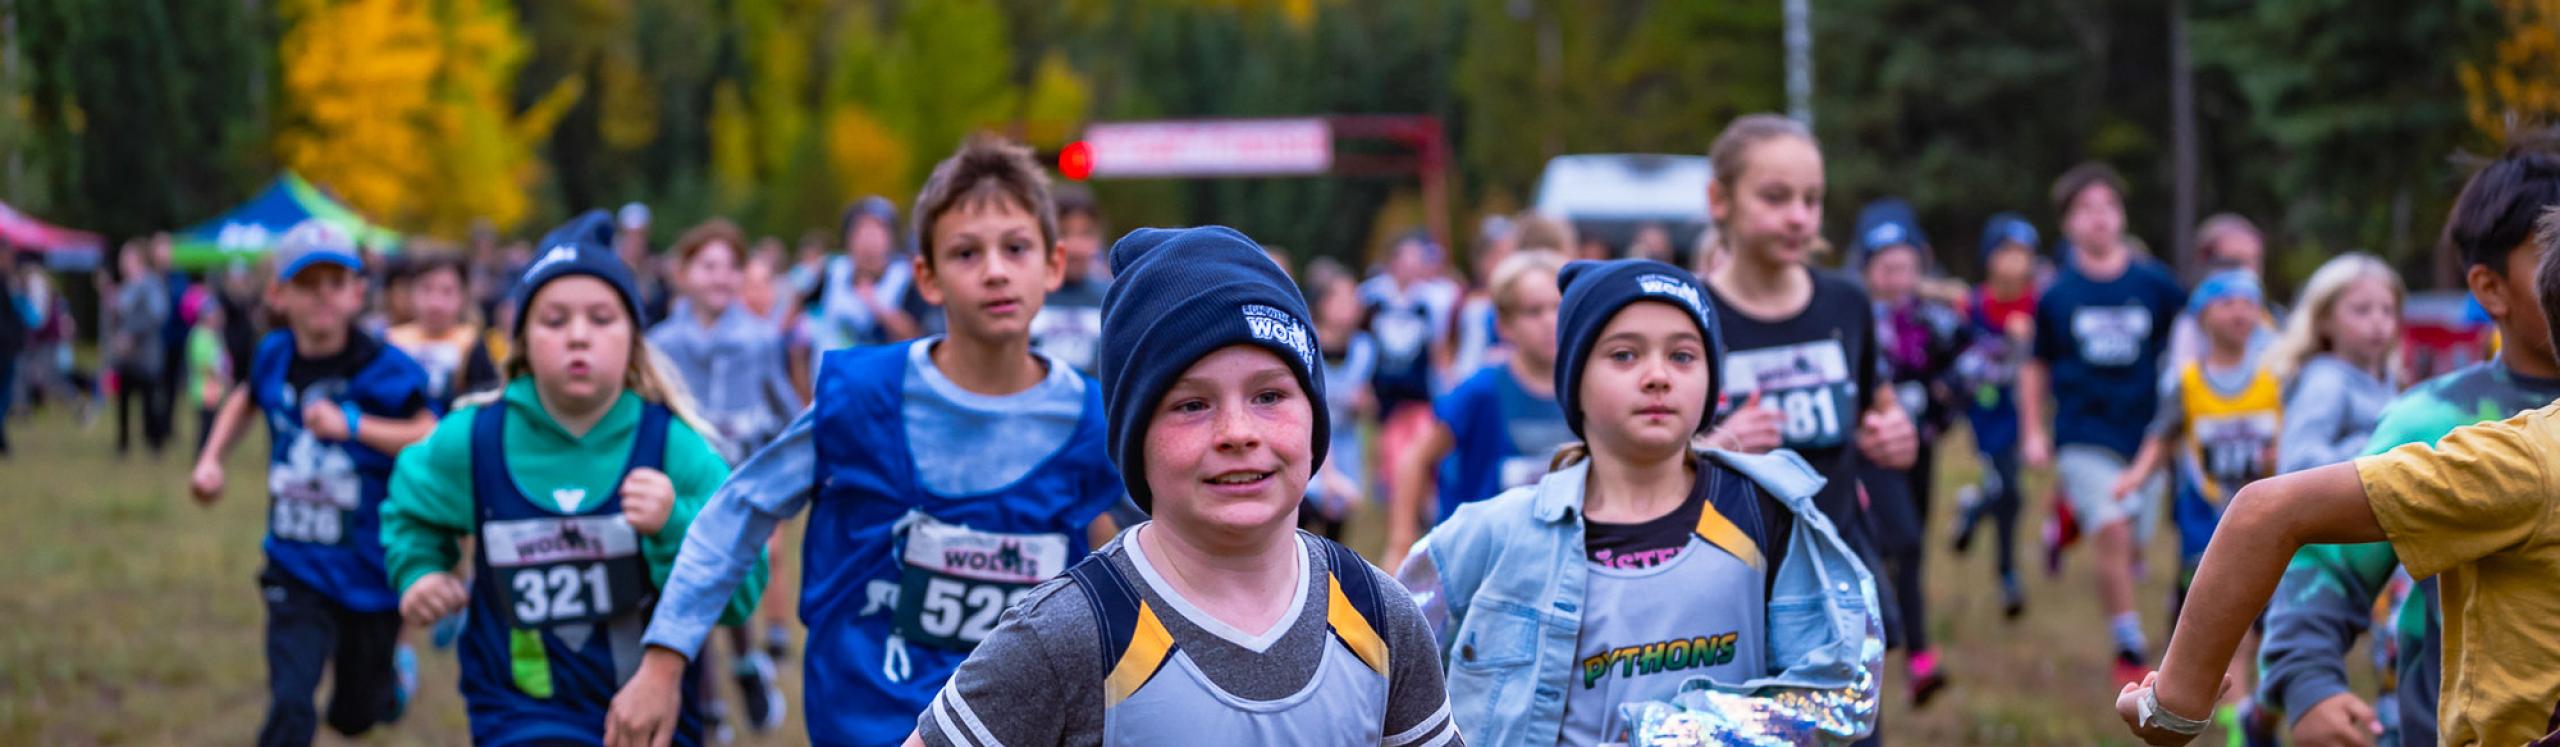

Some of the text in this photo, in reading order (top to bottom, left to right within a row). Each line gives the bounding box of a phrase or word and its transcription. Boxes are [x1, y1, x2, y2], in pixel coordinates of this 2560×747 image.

[1760, 385, 1839, 441] 81
[512, 561, 613, 624] 321
[919, 576, 1036, 642] 52
[1583, 631, 1739, 690] PYTHONS
